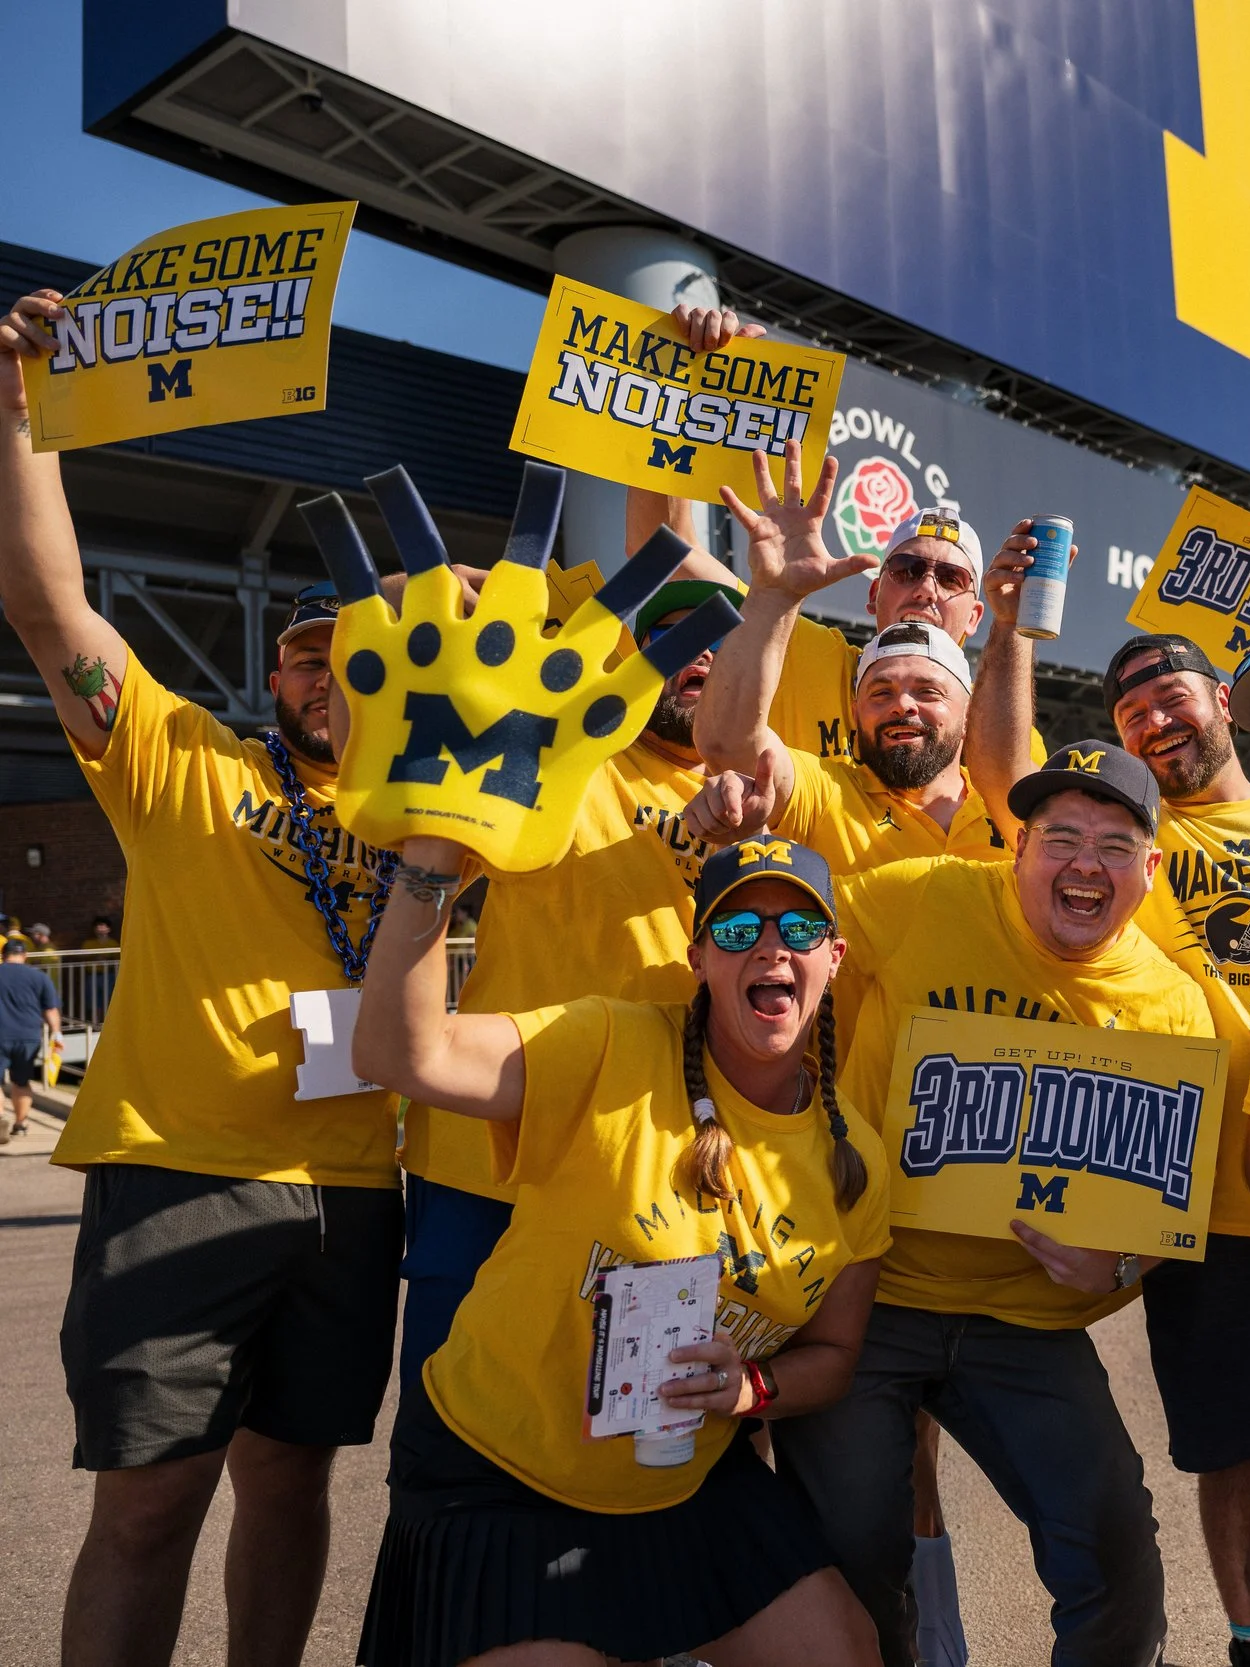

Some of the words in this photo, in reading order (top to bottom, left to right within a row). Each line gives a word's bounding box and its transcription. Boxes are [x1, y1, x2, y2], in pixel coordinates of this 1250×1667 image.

[68, 244, 186, 298] AKE
[189, 228, 324, 285] SOME
[48, 276, 313, 374] NOISE!!
[563, 306, 696, 384] MAKE
[700, 352, 820, 408] SOME
[147, 359, 194, 403] M
[548, 350, 811, 457] NOISE!!
[647, 438, 697, 475] M
[827, 407, 921, 470] BOWL
[1107, 545, 1155, 590] HO
[387, 691, 559, 810] M
[1064, 750, 1106, 774] M
[738, 840, 793, 867] M
[1228, 972, 1250, 986] BIG
[993, 1048, 1037, 1059] GET
[1047, 1050, 1082, 1064] UP!
[1090, 1056, 1133, 1072] IT'S
[899, 1052, 1028, 1178] 3RD
[1018, 1063, 1205, 1212] DOWN!
[1016, 1172, 1069, 1214] M
